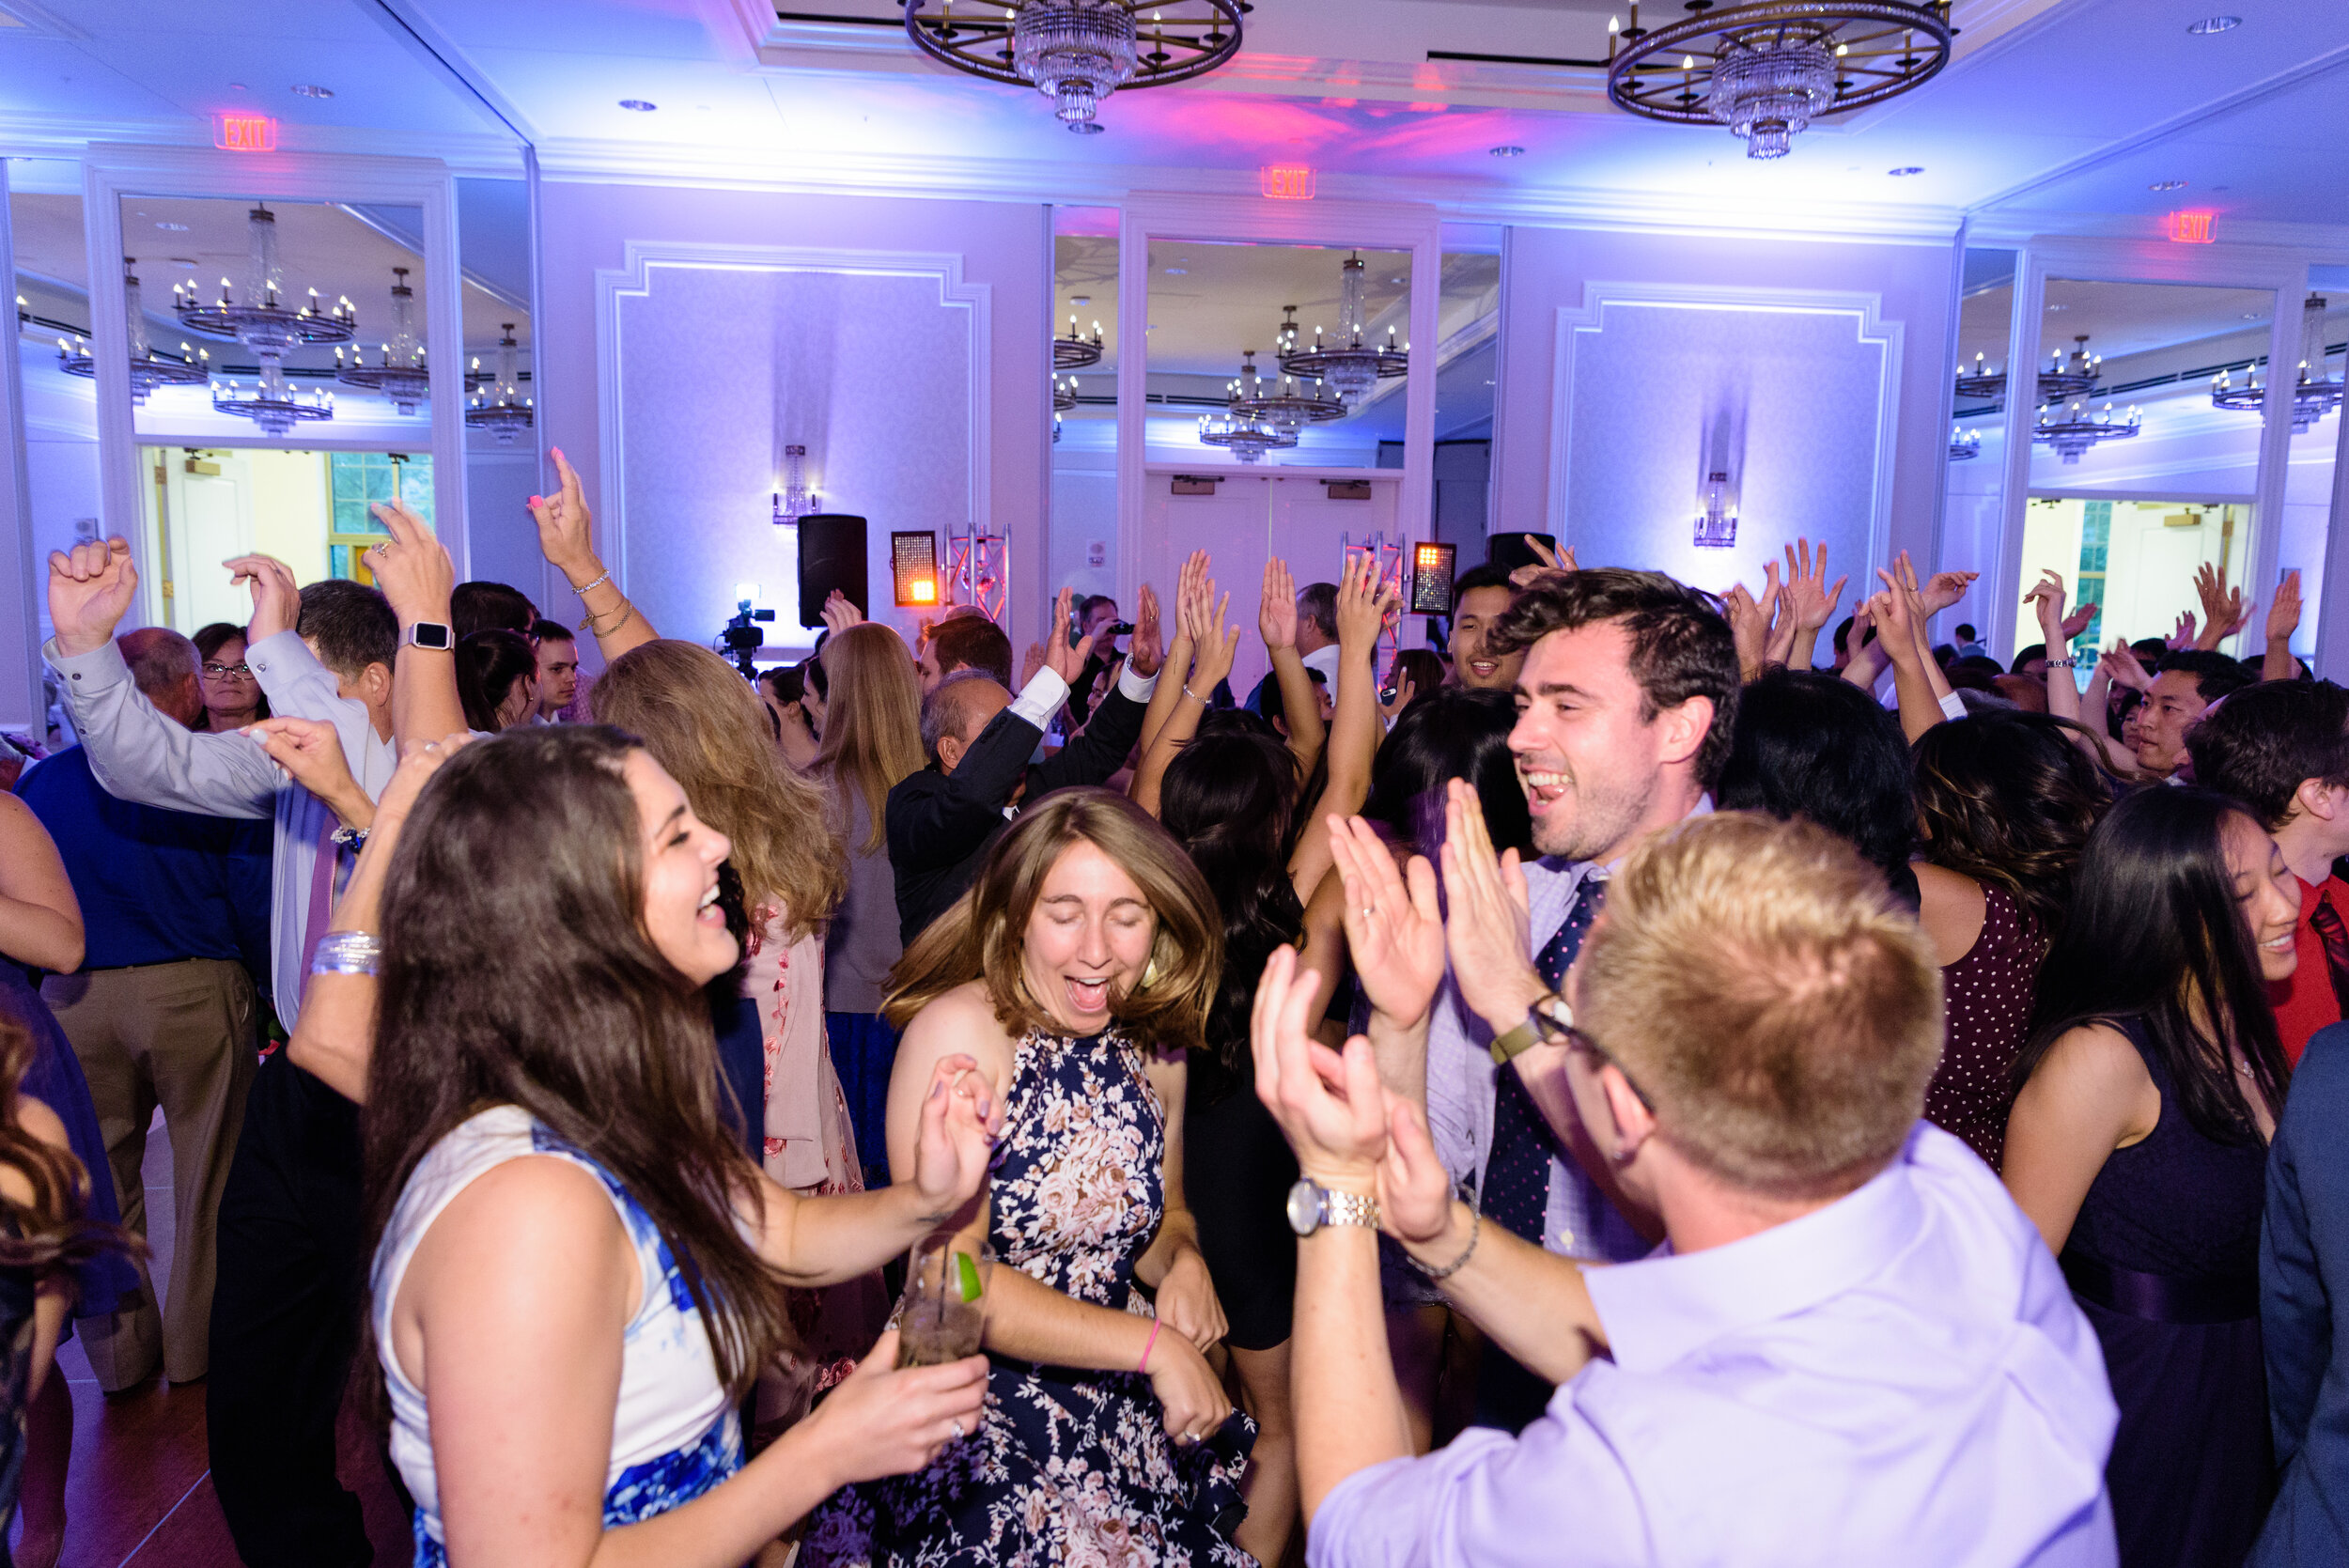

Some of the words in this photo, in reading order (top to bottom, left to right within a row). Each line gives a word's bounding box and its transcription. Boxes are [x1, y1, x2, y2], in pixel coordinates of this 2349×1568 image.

[225, 119, 266, 147] EXIT
[1272, 169, 1308, 196] EXIT
[2179, 214, 2212, 241] EXIT
